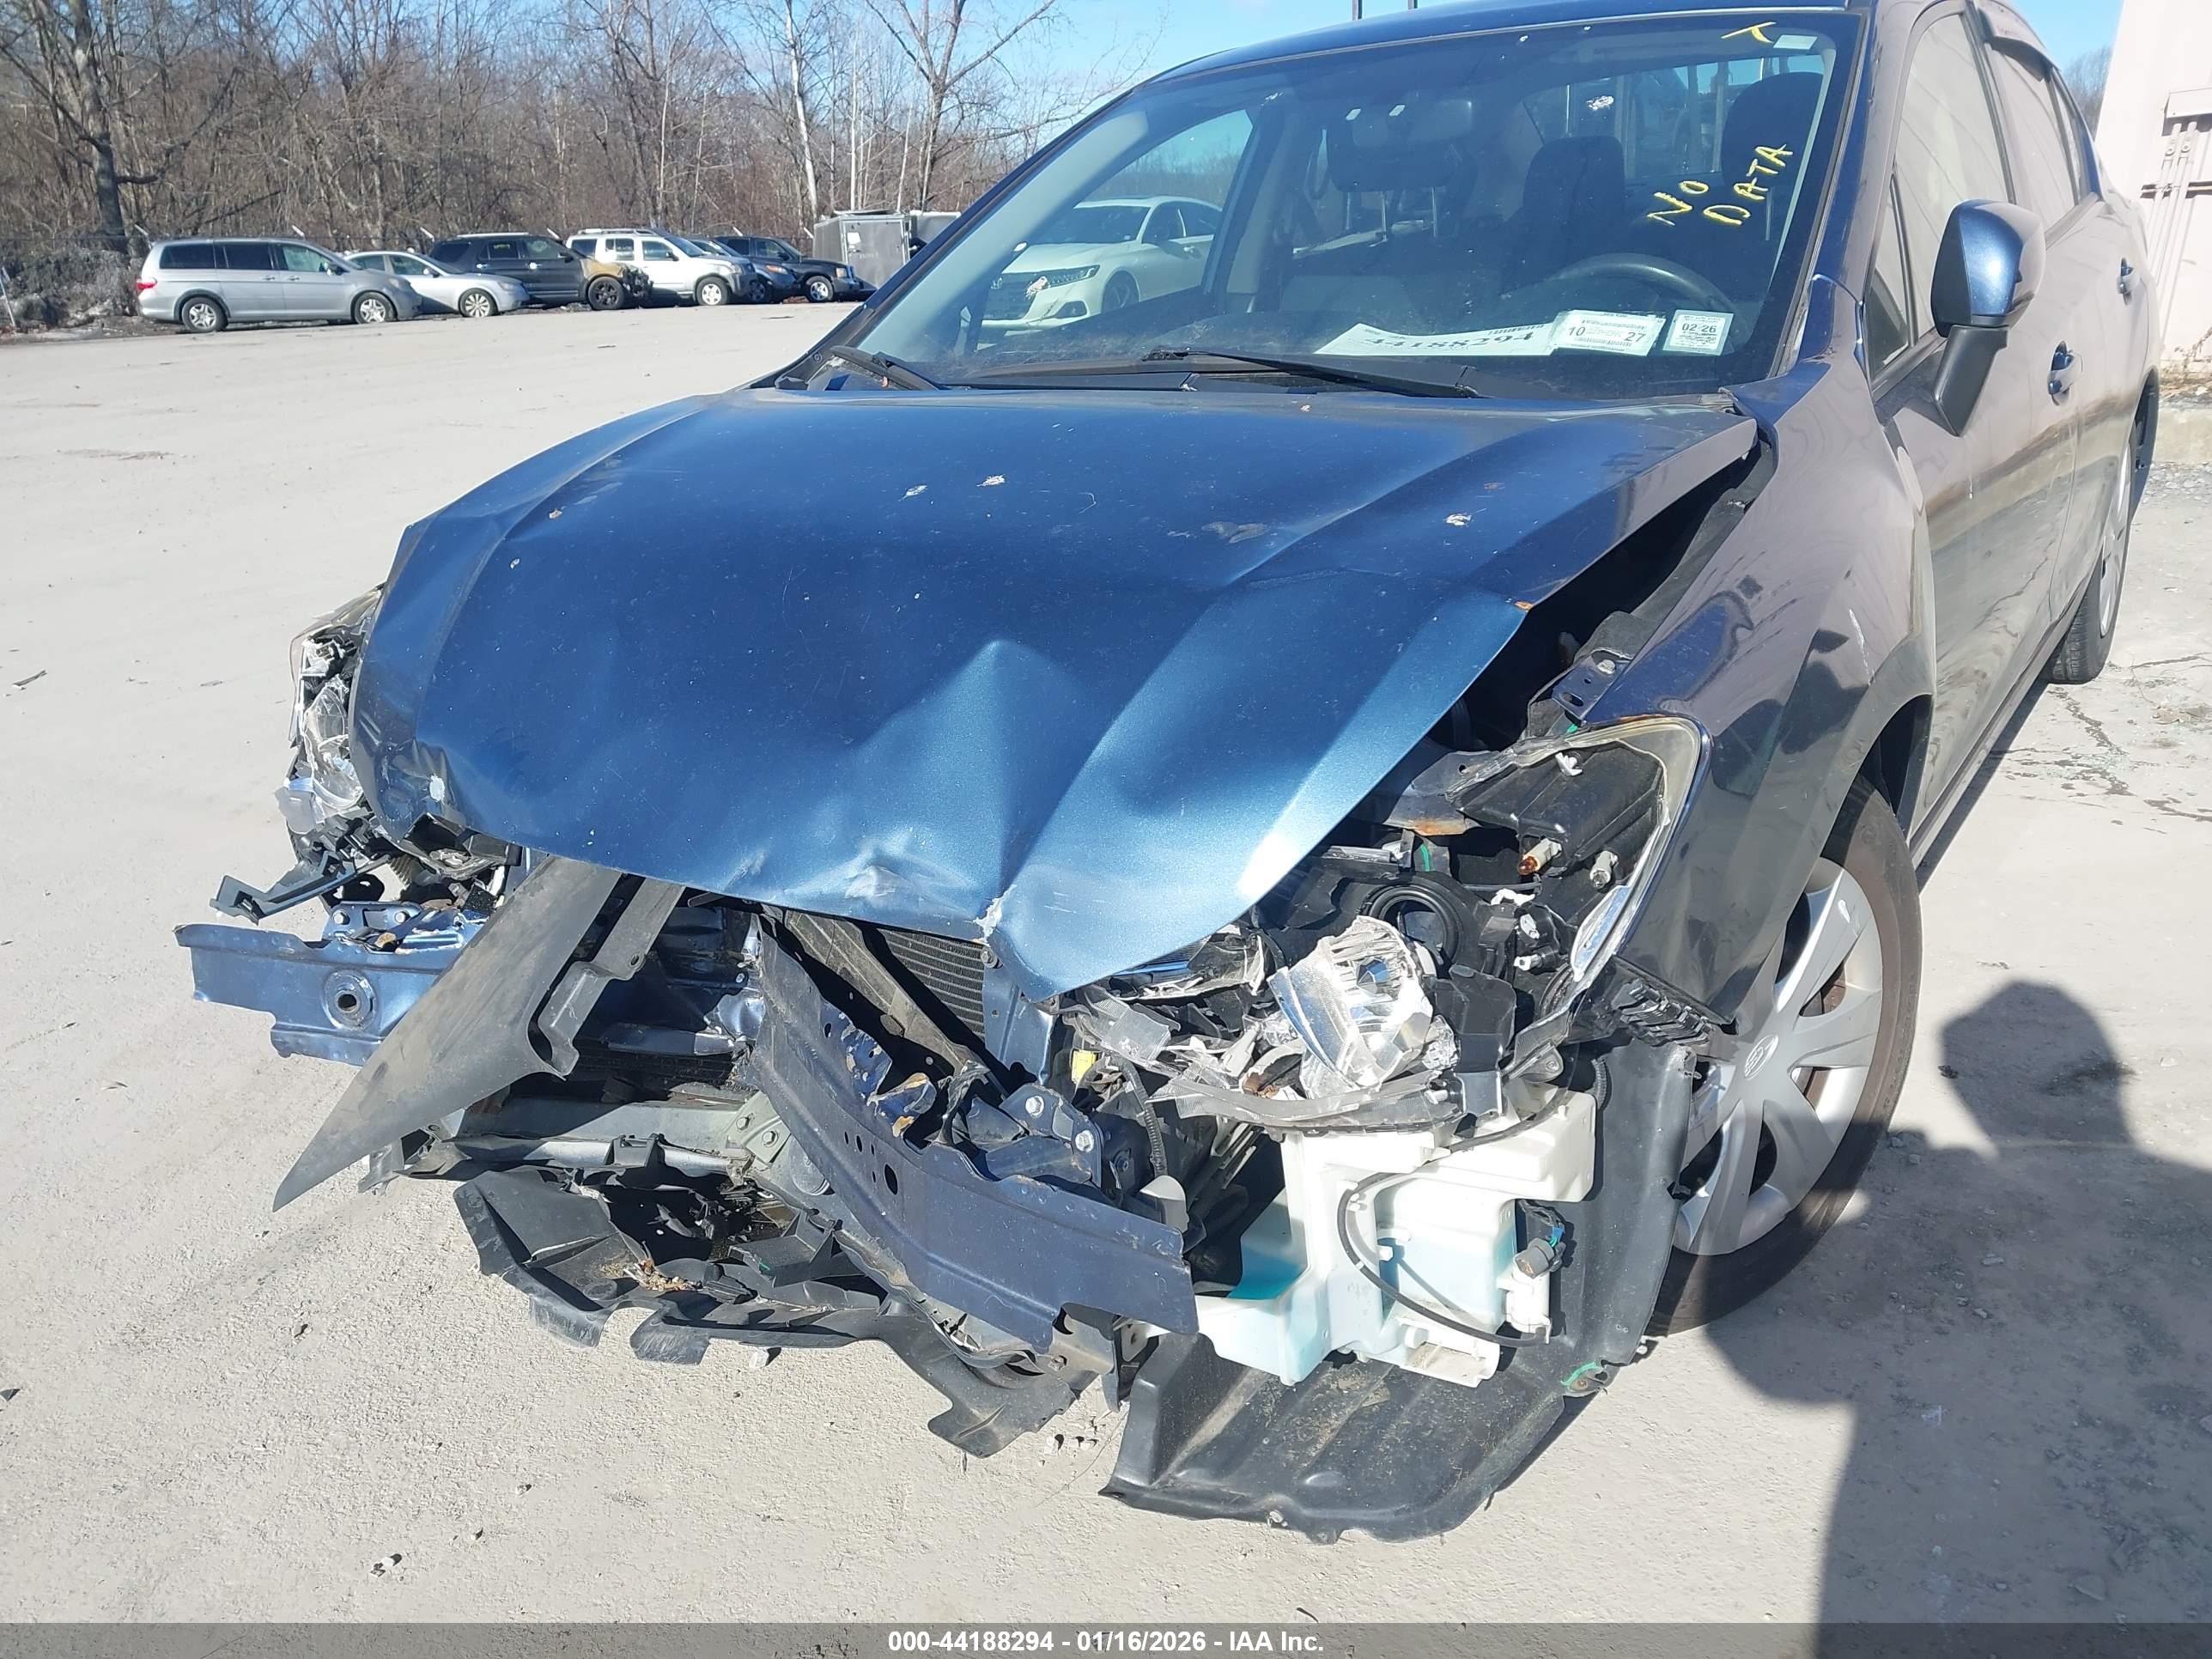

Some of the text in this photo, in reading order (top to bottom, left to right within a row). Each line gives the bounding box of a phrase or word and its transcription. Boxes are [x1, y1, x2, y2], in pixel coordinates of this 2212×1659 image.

[1704, 144, 1793, 225] DATA
[1568, 325, 1586, 337] 10
[1623, 331, 1647, 343] 27
[1682, 323, 1717, 333] 02 26
